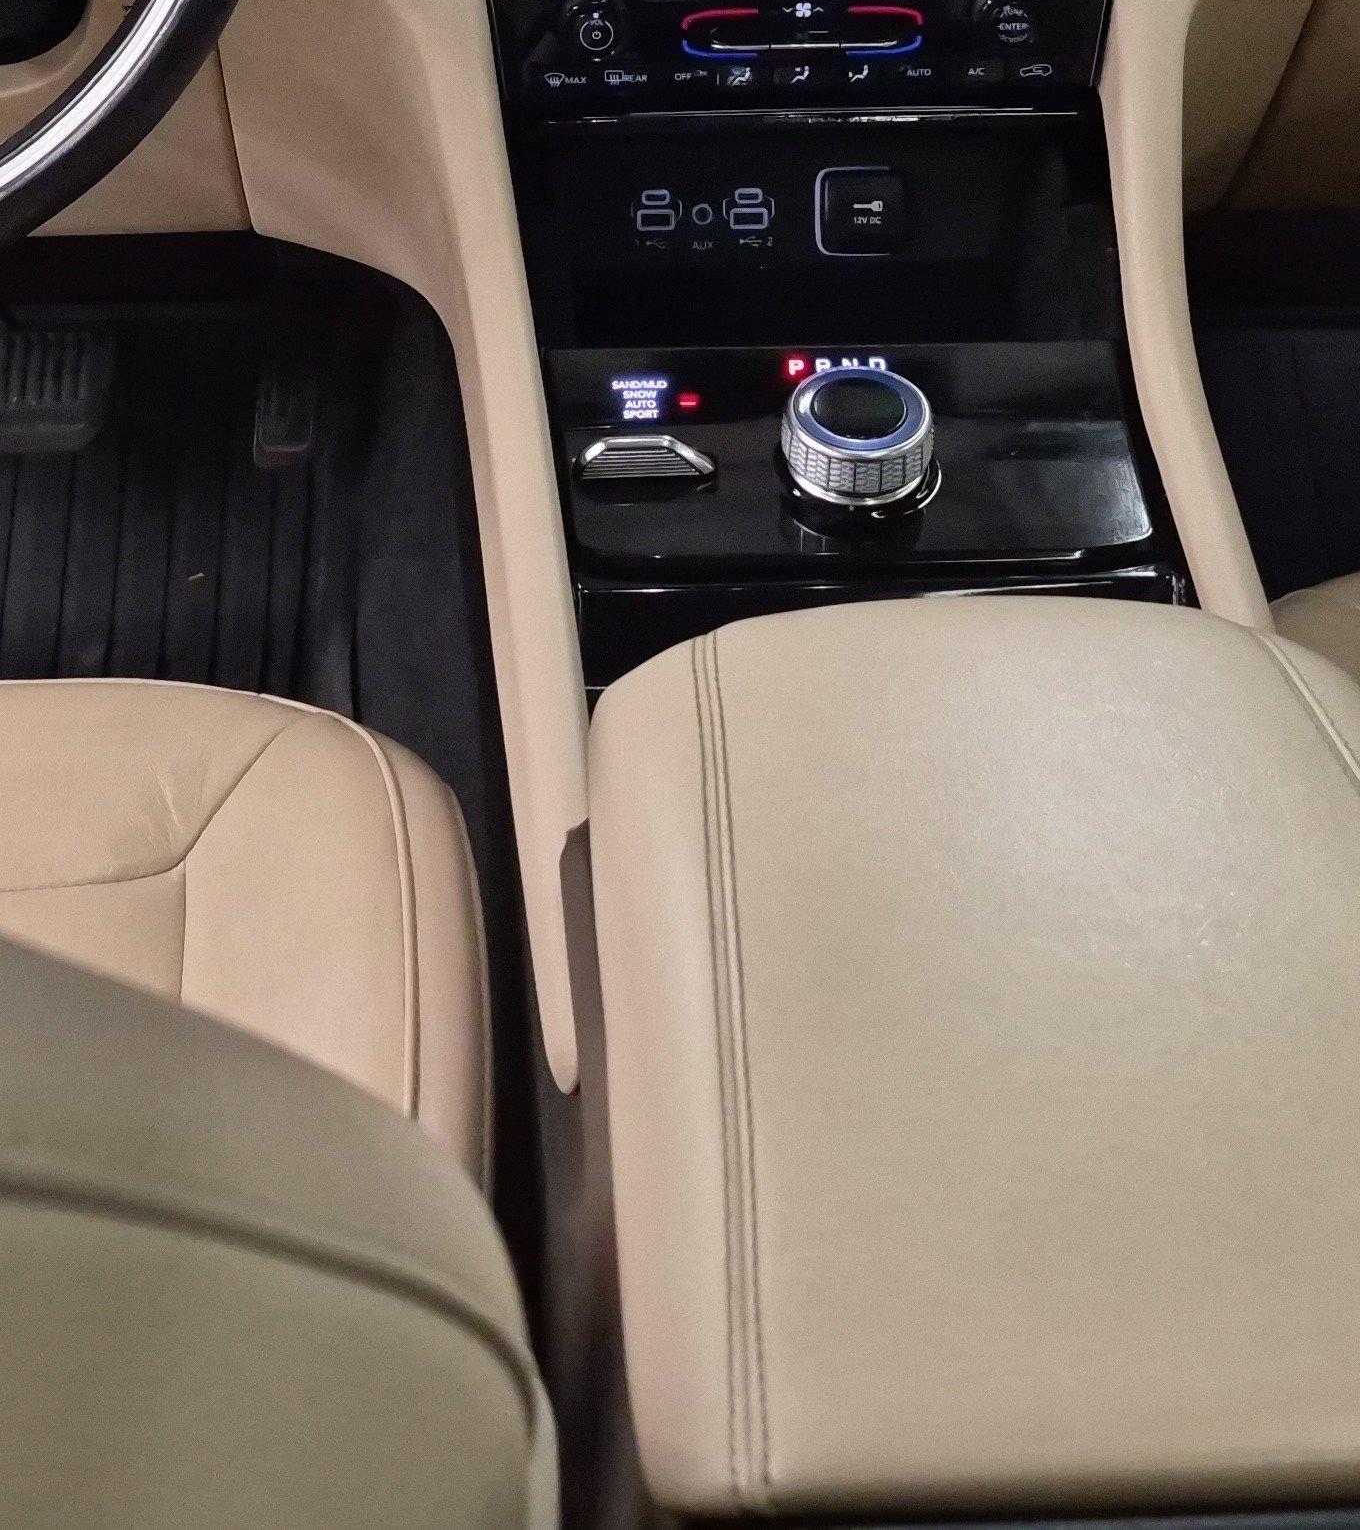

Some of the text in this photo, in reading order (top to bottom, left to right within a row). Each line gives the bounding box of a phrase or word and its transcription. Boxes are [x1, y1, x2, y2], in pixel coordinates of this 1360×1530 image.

[999, 22, 1030, 31] ENTER
[674, 72, 692, 81] OFF
[906, 68, 932, 77] AUTO
[968, 67, 986, 76] A/C
[564, 76, 587, 85] MAX
[624, 73, 648, 83] REAR
[853, 216, 882, 225] 12V DC
[692, 241, 714, 251] AUX
[766, 236, 774, 247] 2
[789, 359, 805, 376] P
[611, 380, 668, 390] SAND/MUD
[623, 390, 657, 400] SNOW
[625, 400, 657, 410] AUTO
[623, 409, 659, 419] SPORT
